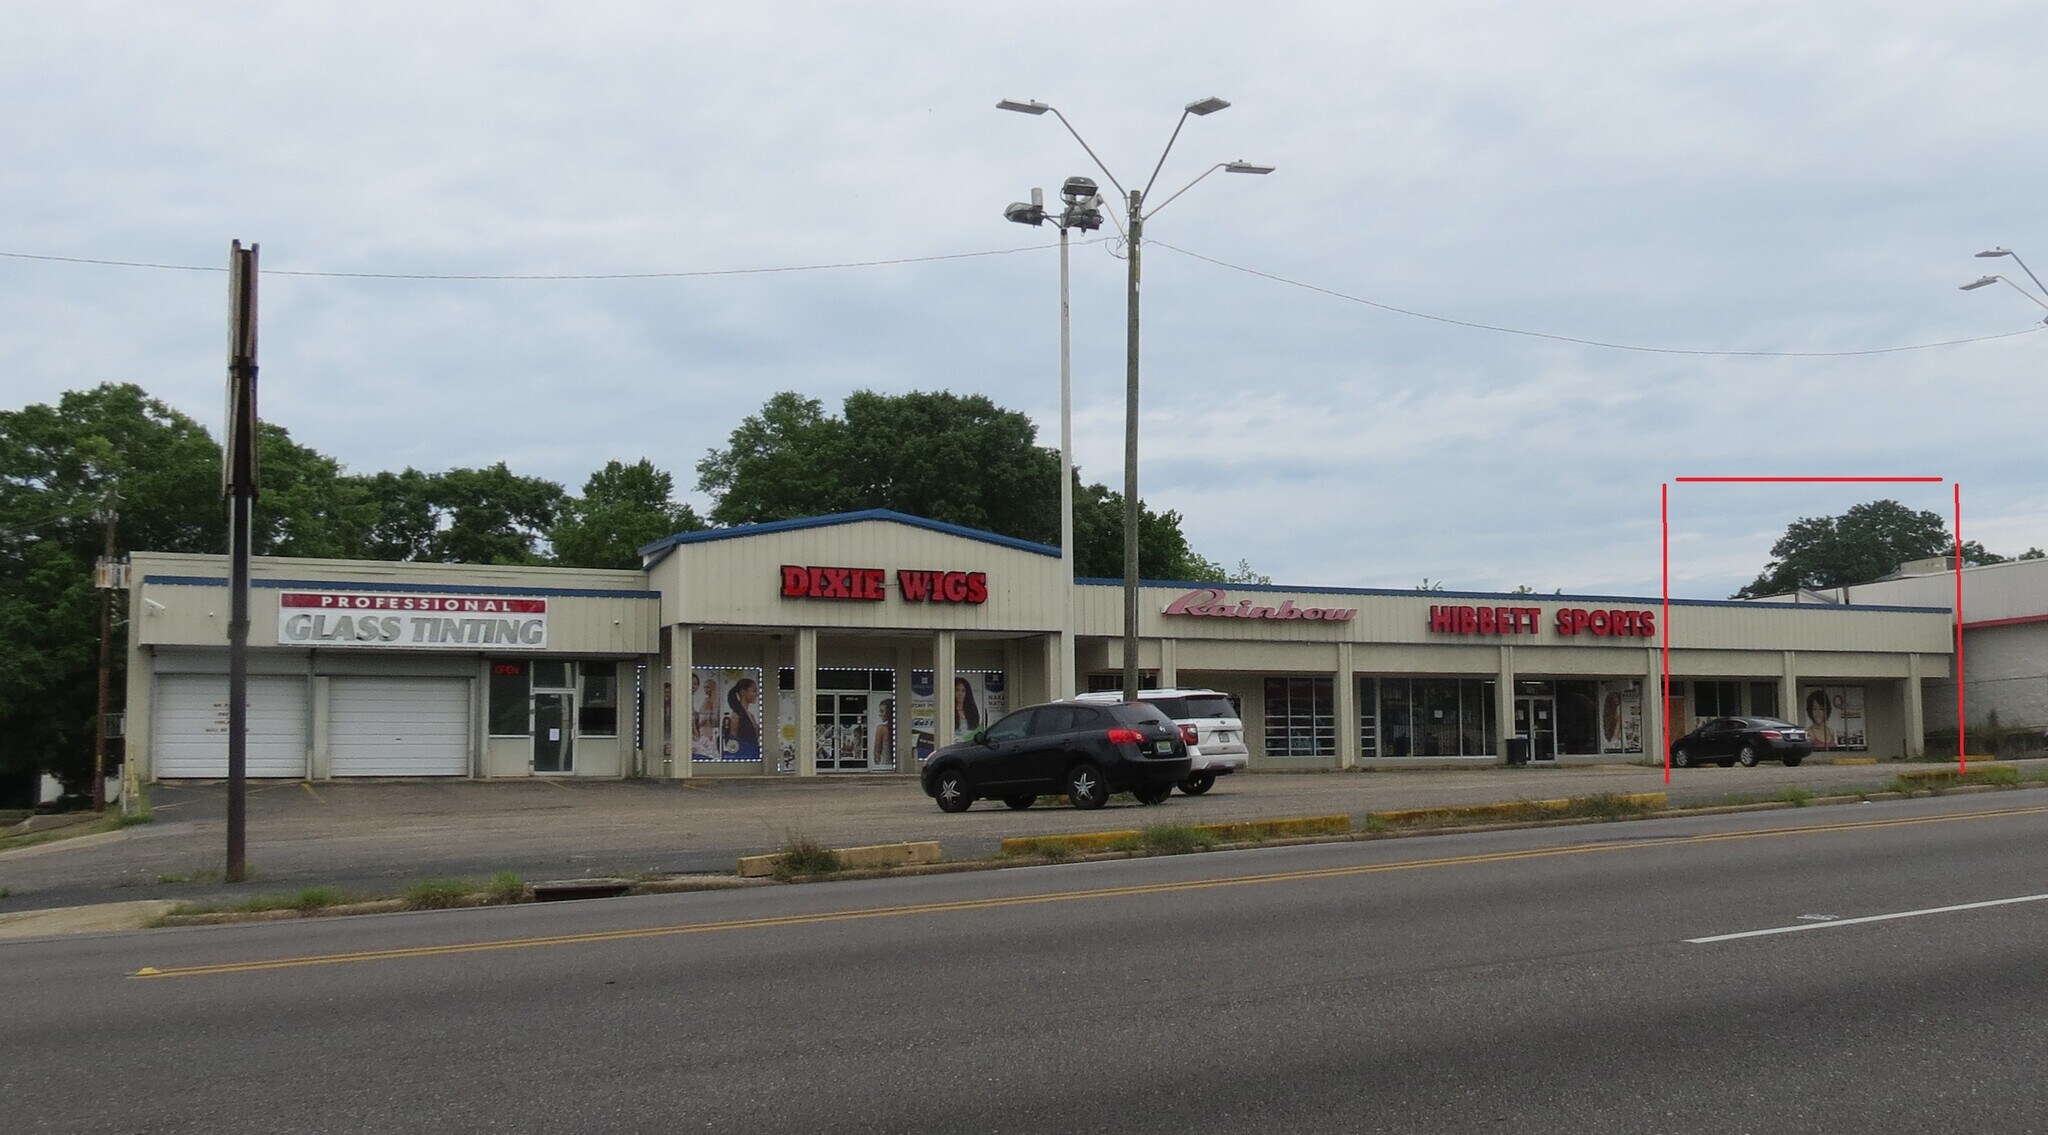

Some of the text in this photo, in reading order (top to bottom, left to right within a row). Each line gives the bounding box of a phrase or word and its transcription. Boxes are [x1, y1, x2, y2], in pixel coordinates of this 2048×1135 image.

[780, 565, 988, 604] DIXIE WIGS
[321, 596, 511, 612] PROFESSIONAL
[1162, 589, 1358, 621] Rainbow
[286, 614, 543, 645] GLASS TINTING
[1429, 605, 1655, 637] HIBBETT SPORTS
